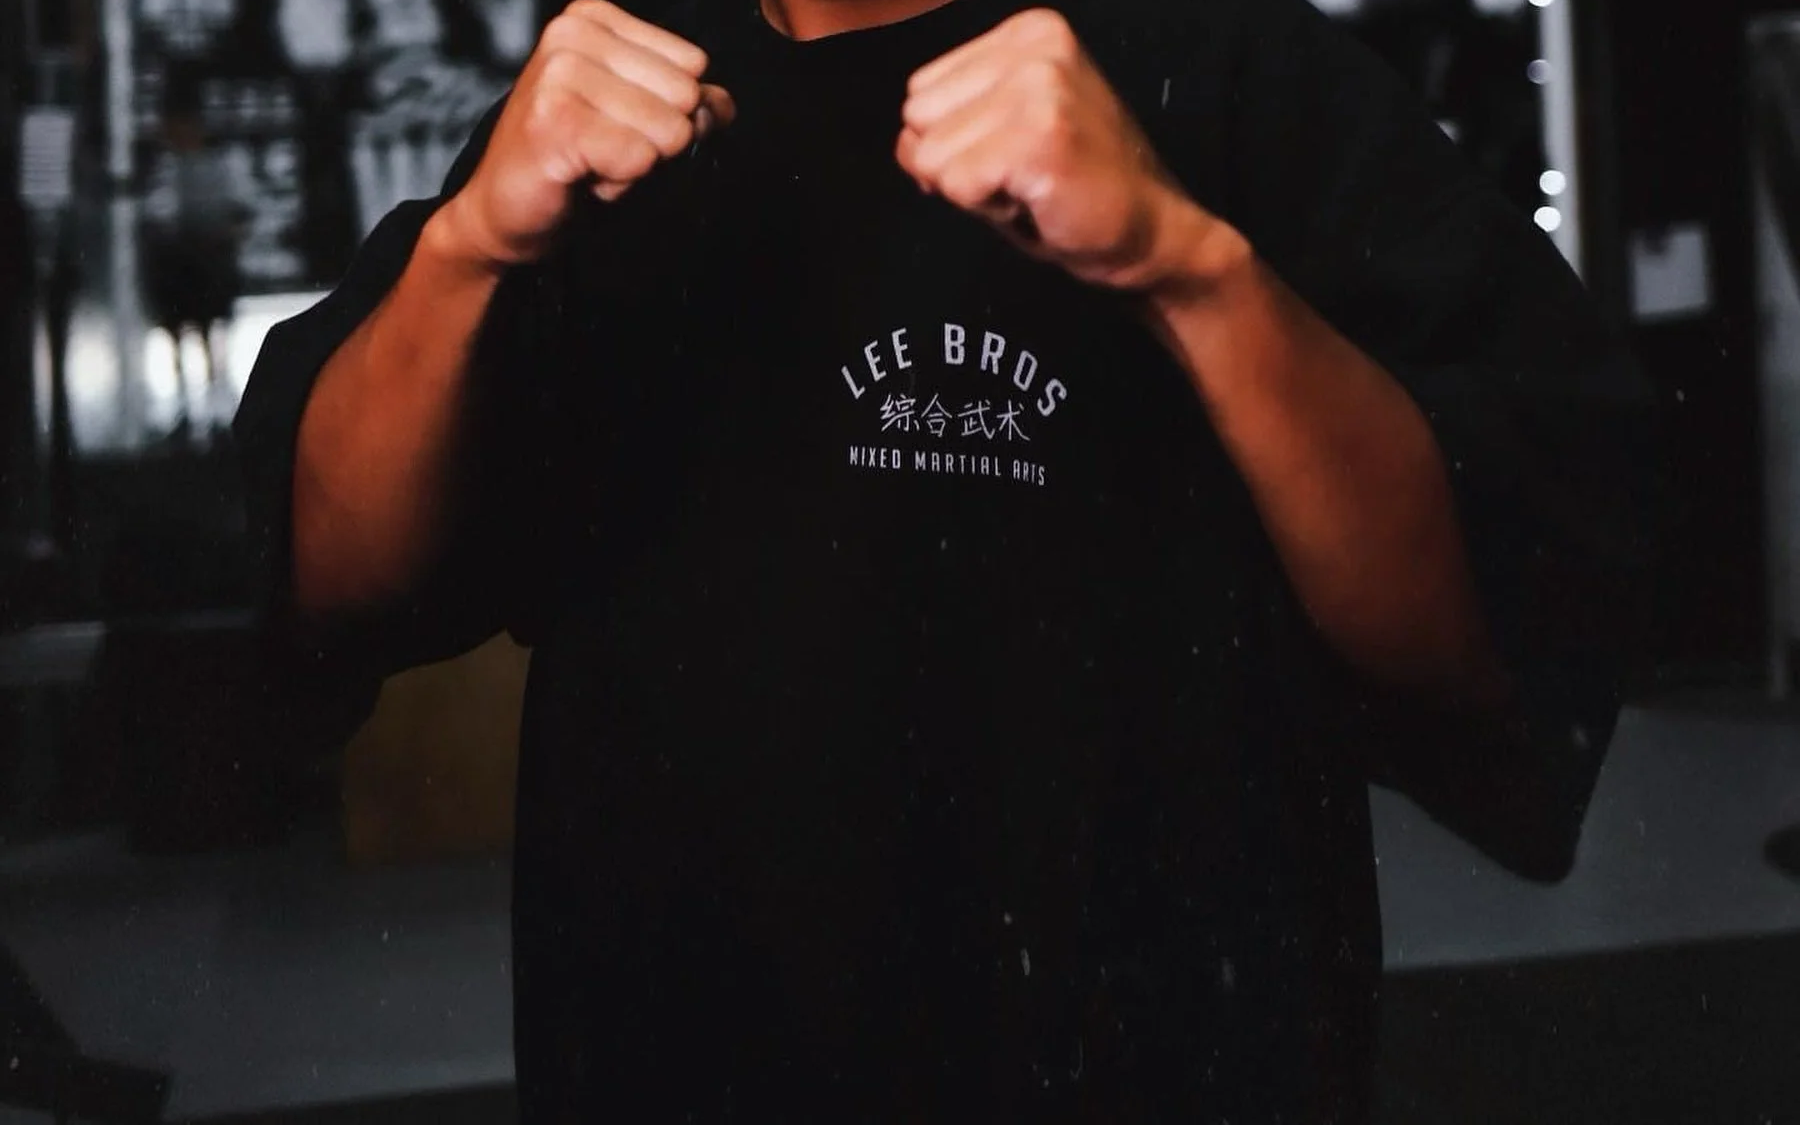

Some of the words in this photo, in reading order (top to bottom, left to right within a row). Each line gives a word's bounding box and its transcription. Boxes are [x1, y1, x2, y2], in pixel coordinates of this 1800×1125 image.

[841, 327, 912, 399] LEE
[944, 323, 1068, 417] BROS
[880, 392, 1030, 441] 综合武术
[849, 445, 901, 470] MIXED
[914, 450, 1001, 477] MARTIAL
[1012, 459, 1045, 486] ARTS
